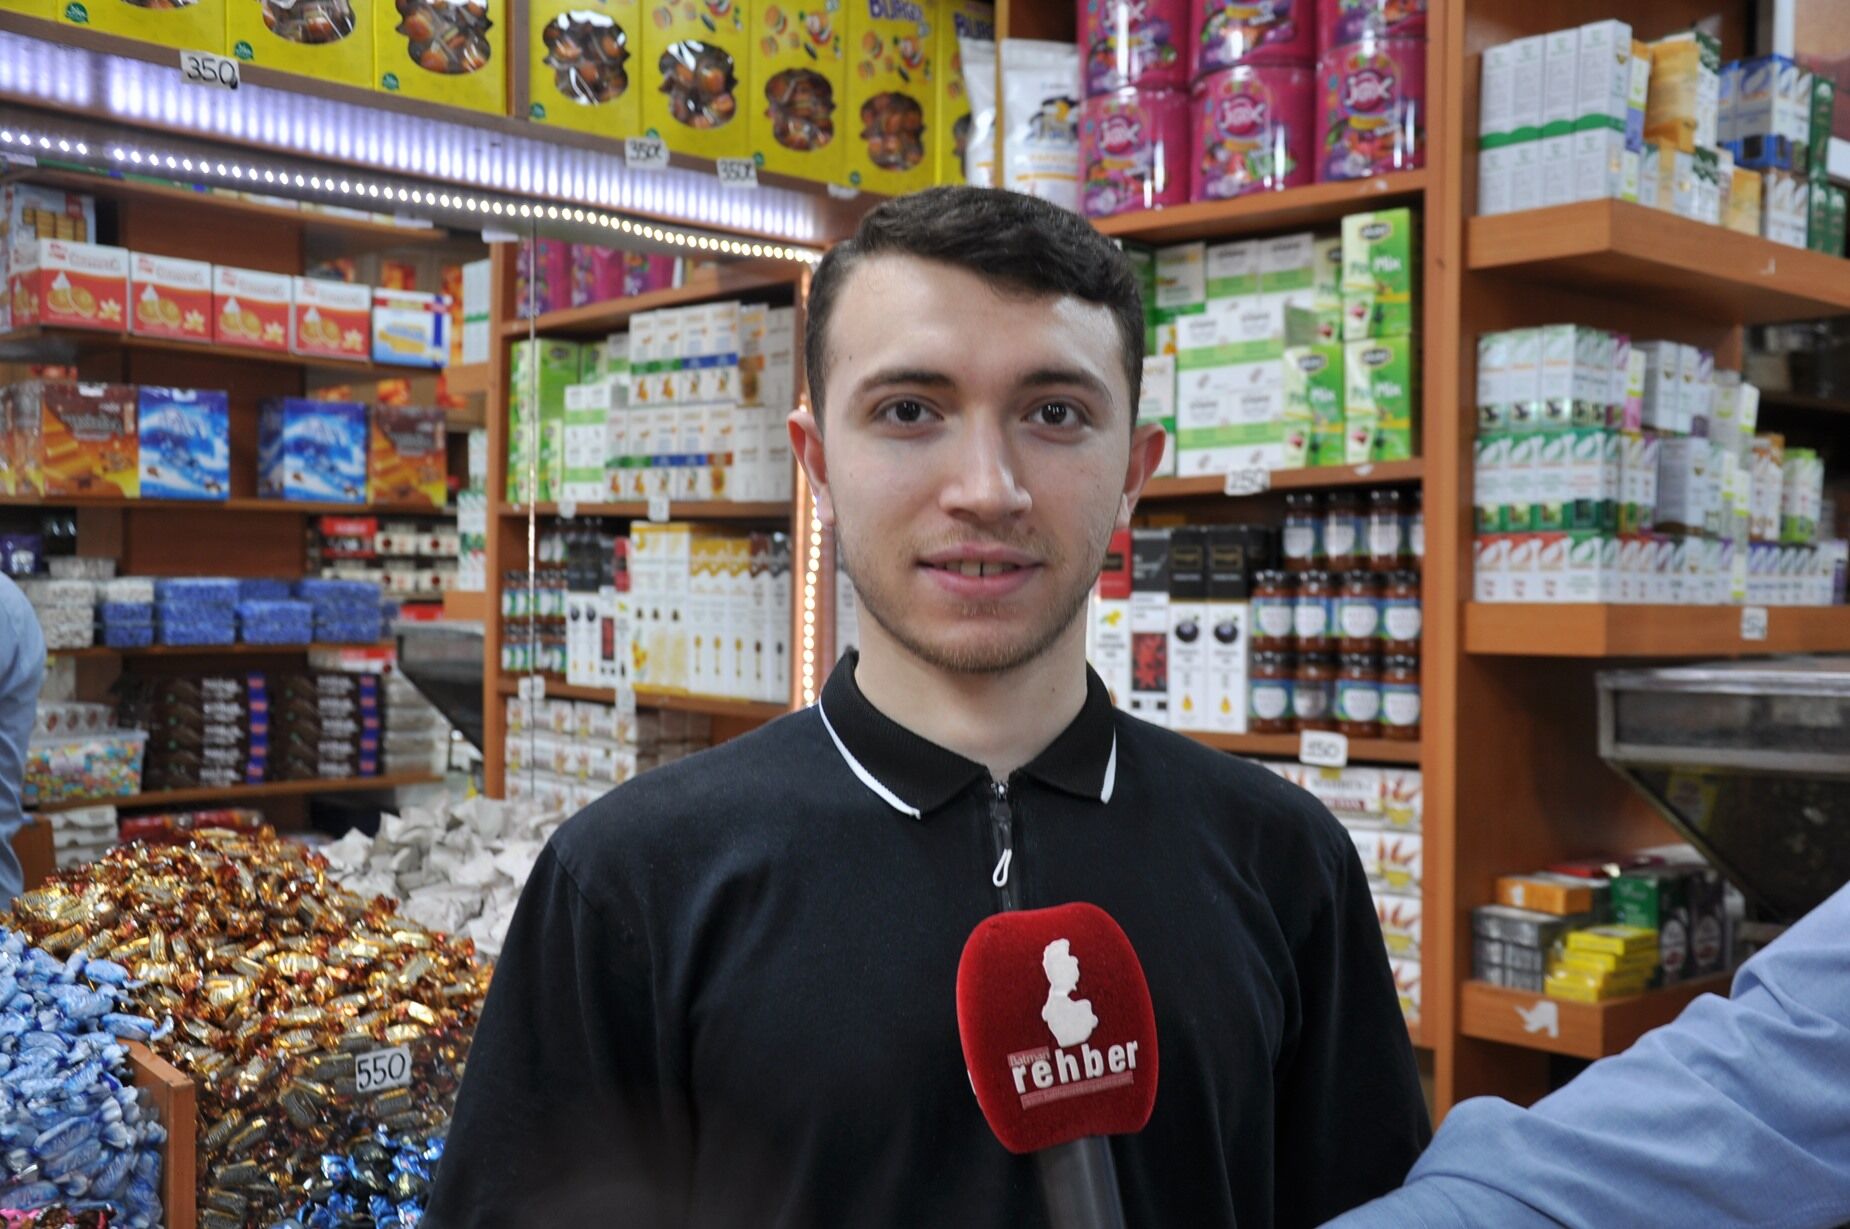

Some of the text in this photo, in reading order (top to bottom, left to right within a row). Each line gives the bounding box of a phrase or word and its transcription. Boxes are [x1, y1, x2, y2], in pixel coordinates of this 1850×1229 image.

[187, 56, 238, 90] 350
[357, 1052, 406, 1089] 550
[1011, 1040, 1138, 1095] rehber
